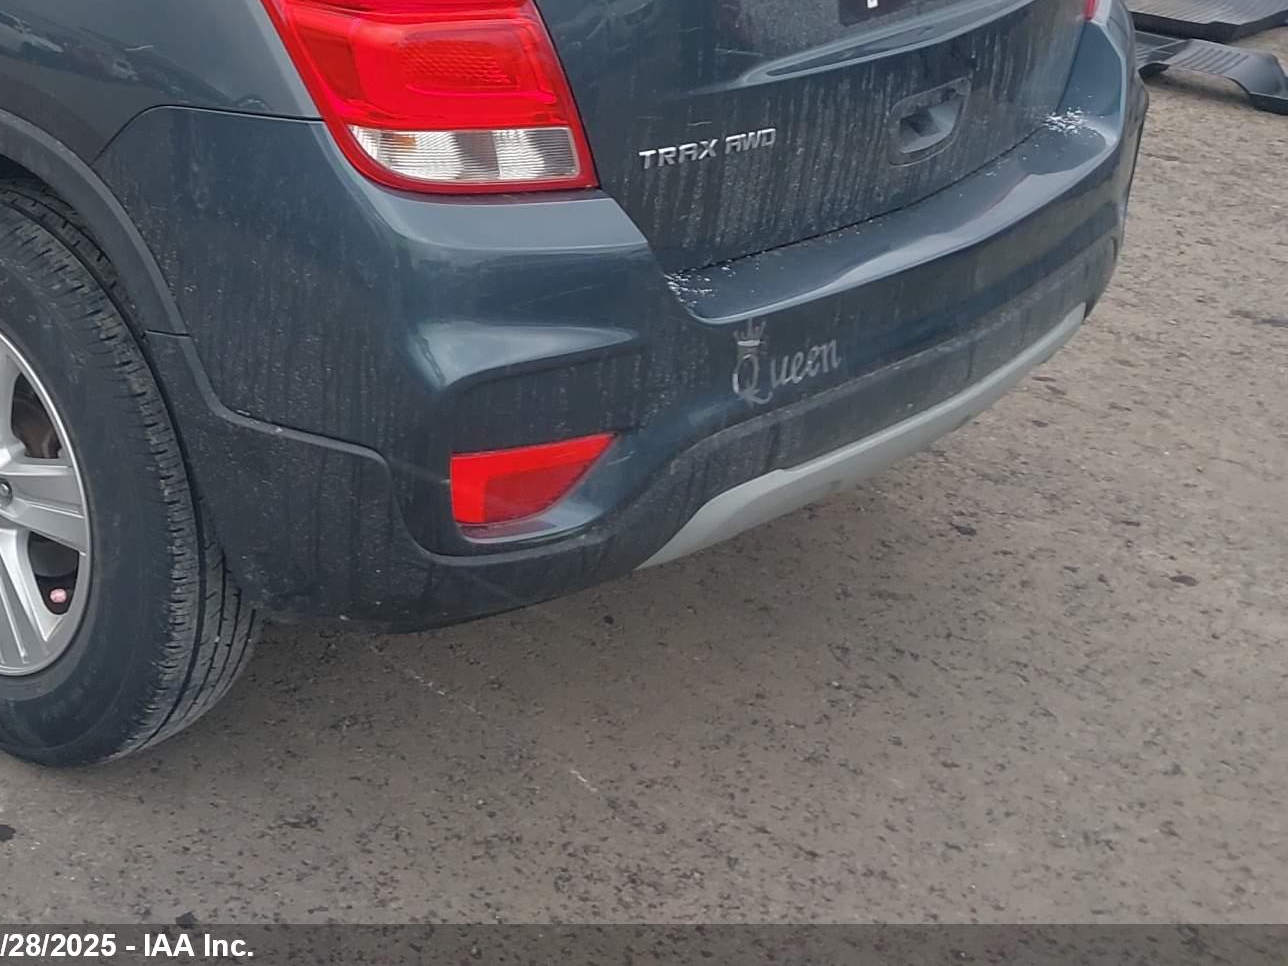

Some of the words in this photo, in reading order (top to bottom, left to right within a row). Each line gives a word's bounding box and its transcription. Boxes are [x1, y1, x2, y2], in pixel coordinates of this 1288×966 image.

[638, 138, 719, 170] TRAX
[725, 128, 777, 155] AWD
[732, 338, 843, 405] Queen
